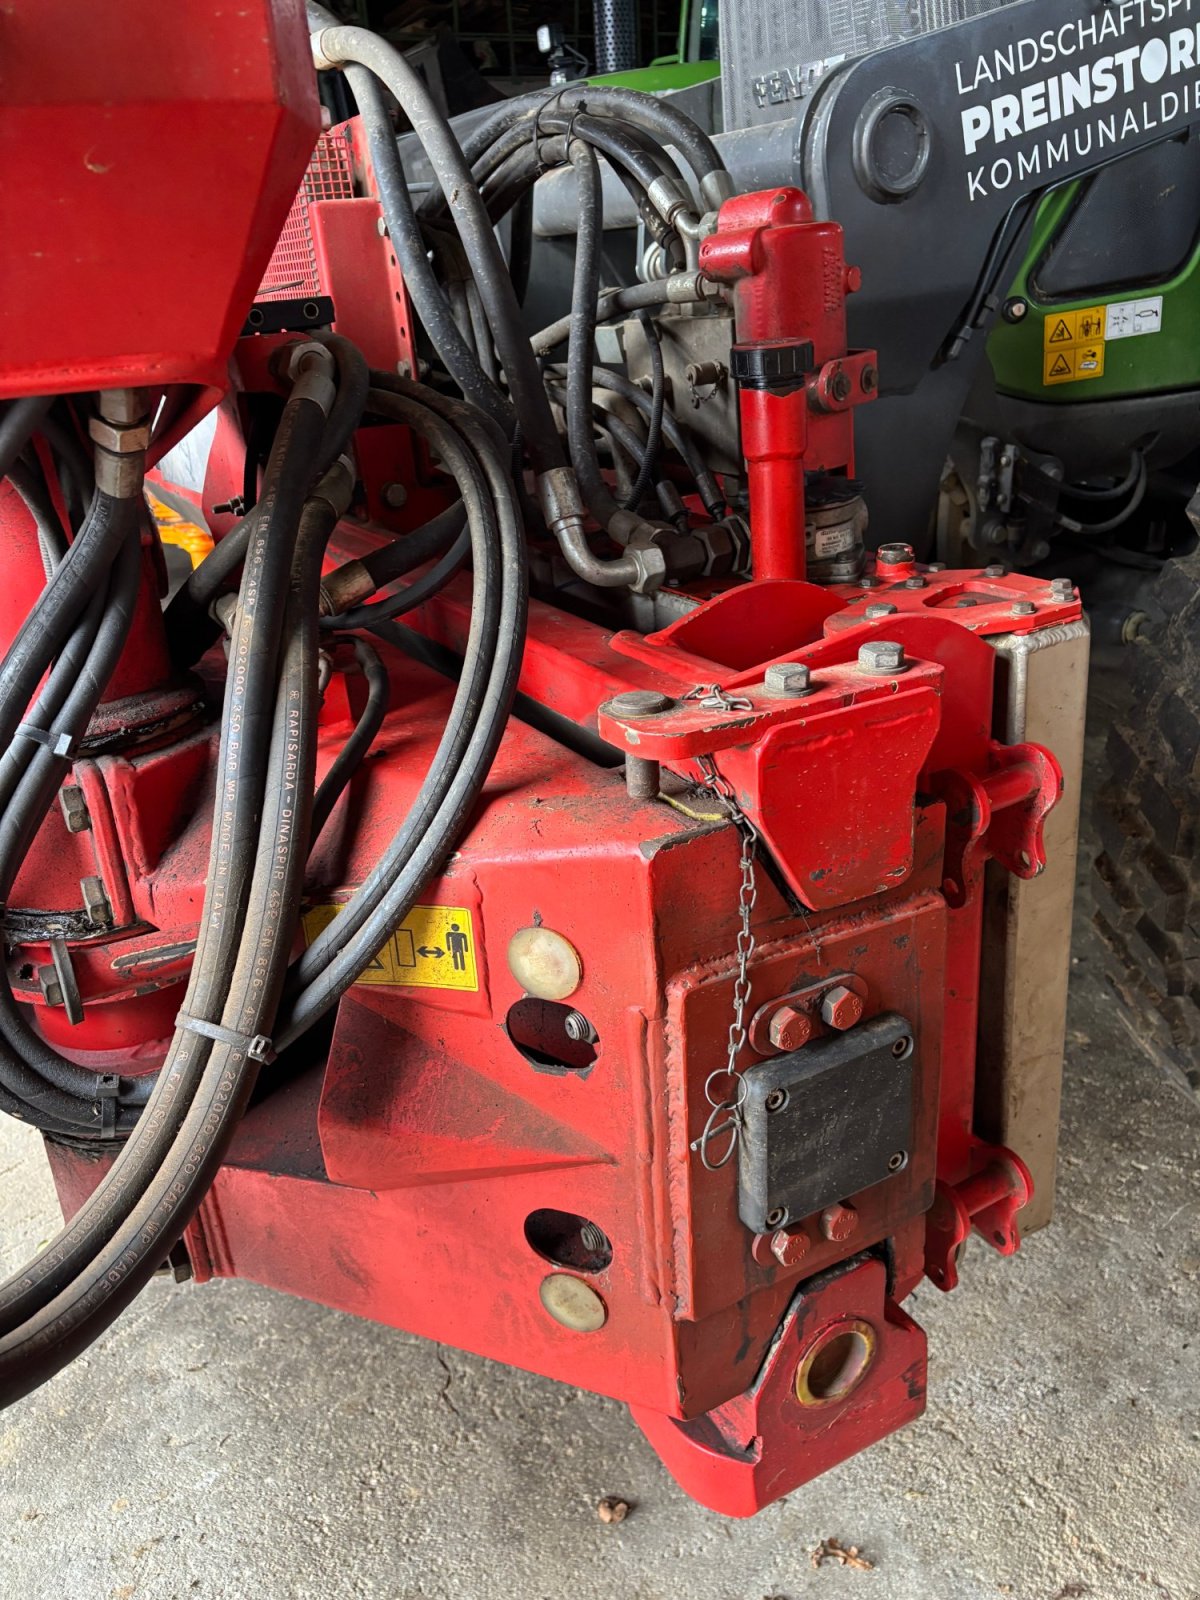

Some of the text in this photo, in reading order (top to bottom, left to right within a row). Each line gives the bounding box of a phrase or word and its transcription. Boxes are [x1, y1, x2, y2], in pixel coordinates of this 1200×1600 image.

[955, 0, 1192, 95] LANDSCHAFTSP
[960, 22, 1200, 156] PREINSTOR
[227, 742, 240, 771] BAR
[284, 710, 299, 791] RAPISARDA
[226, 780, 236, 801] WP
[222, 811, 233, 852] MADE
[273, 809, 293, 880] DINASPIR
[217, 860, 228, 875] IN
[209, 885, 225, 929] ITALY
